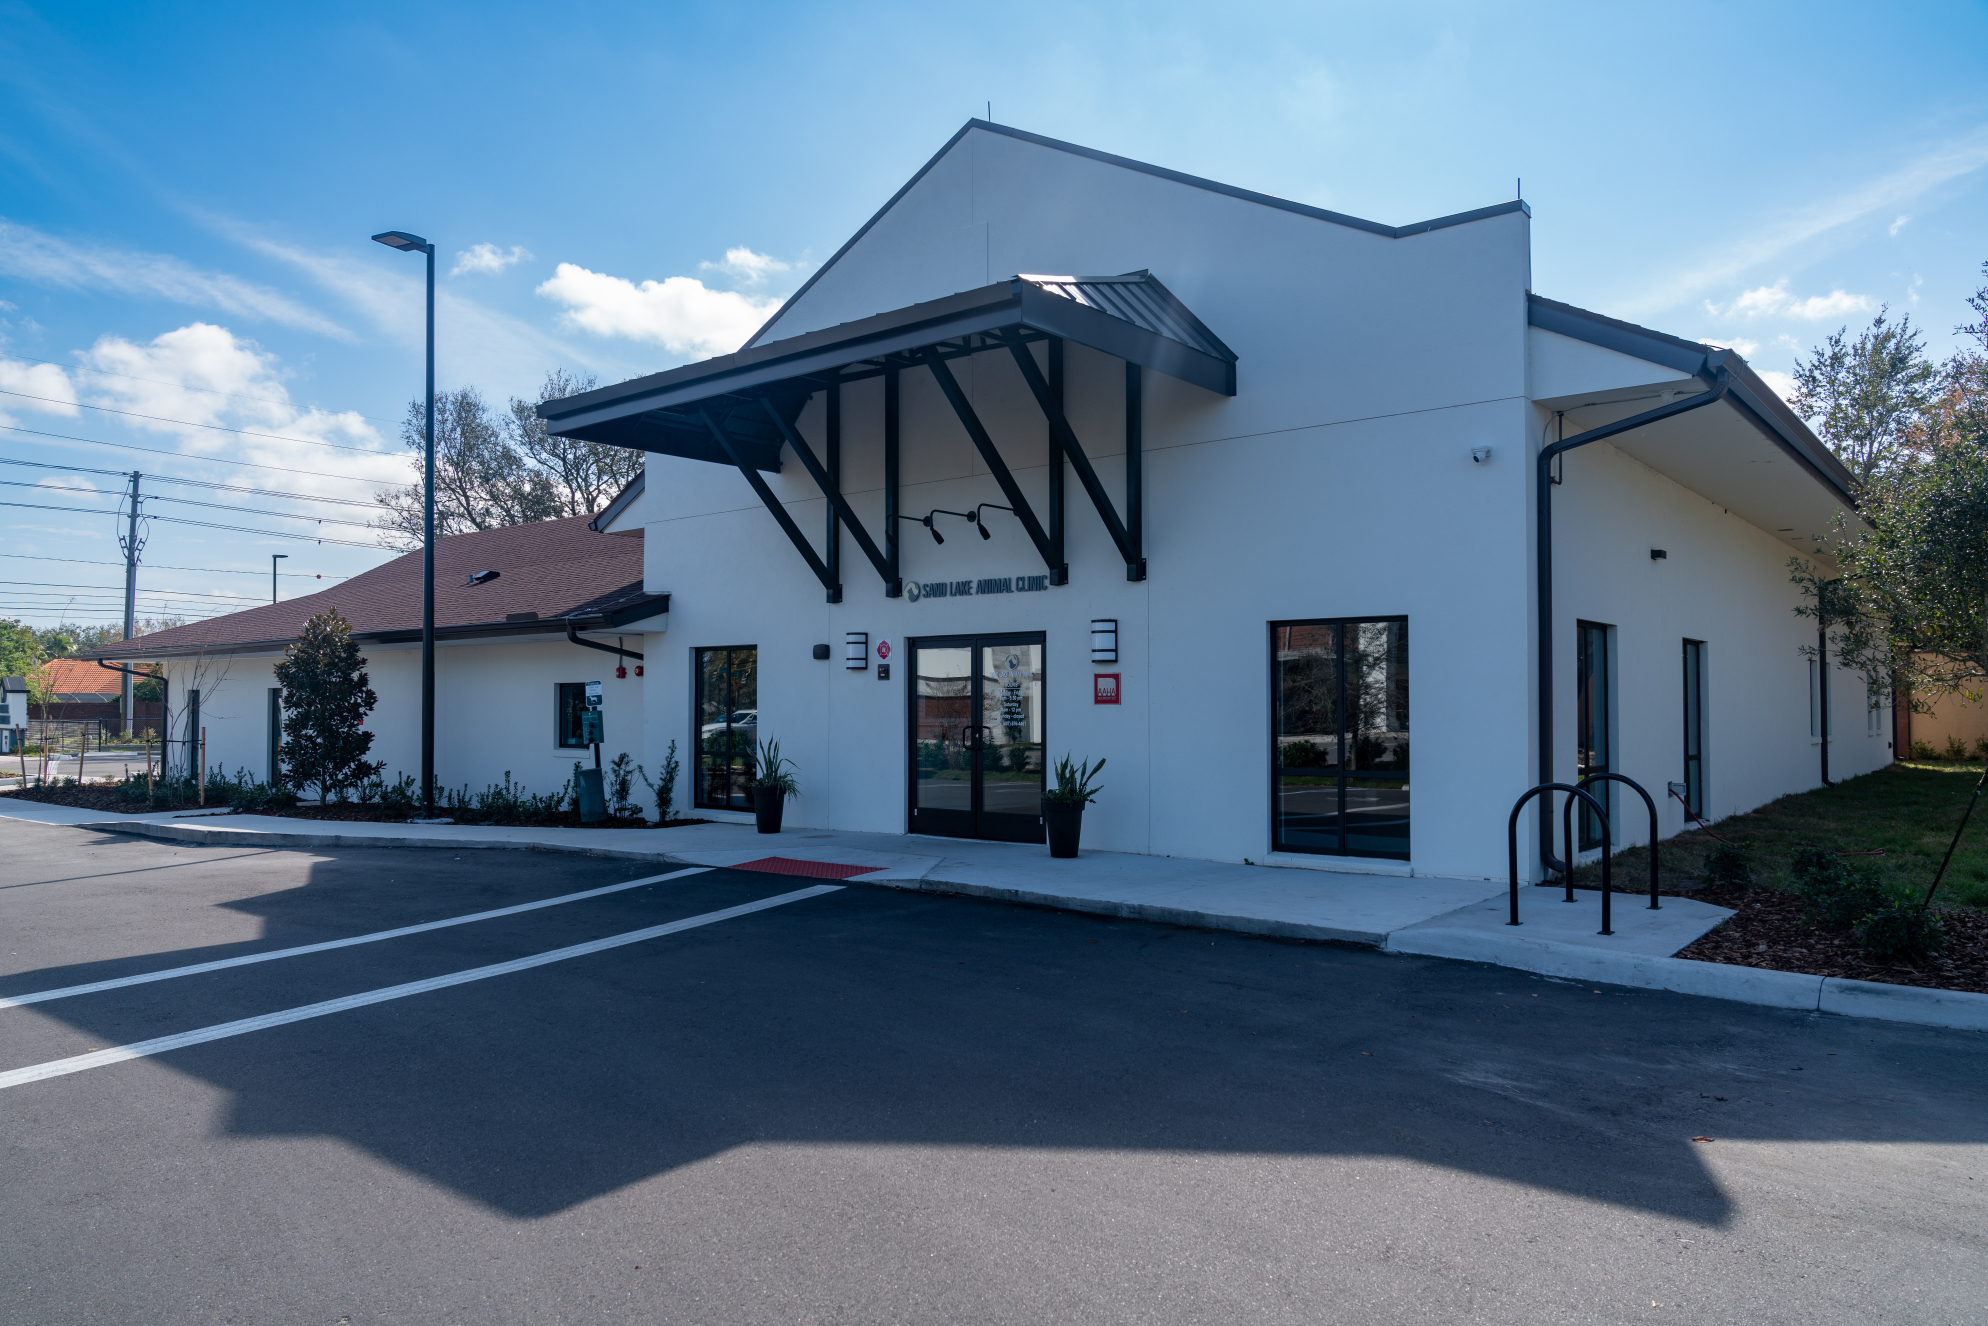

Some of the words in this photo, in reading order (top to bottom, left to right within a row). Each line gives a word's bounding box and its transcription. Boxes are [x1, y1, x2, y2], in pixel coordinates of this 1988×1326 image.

[922, 582, 948, 599] SAND
[949, 580, 973, 597] LAKE
[976, 577, 1014, 595] ANIMAL
[1016, 575, 1048, 592] CLINIC
[1098, 688, 1116, 696] AAHA
